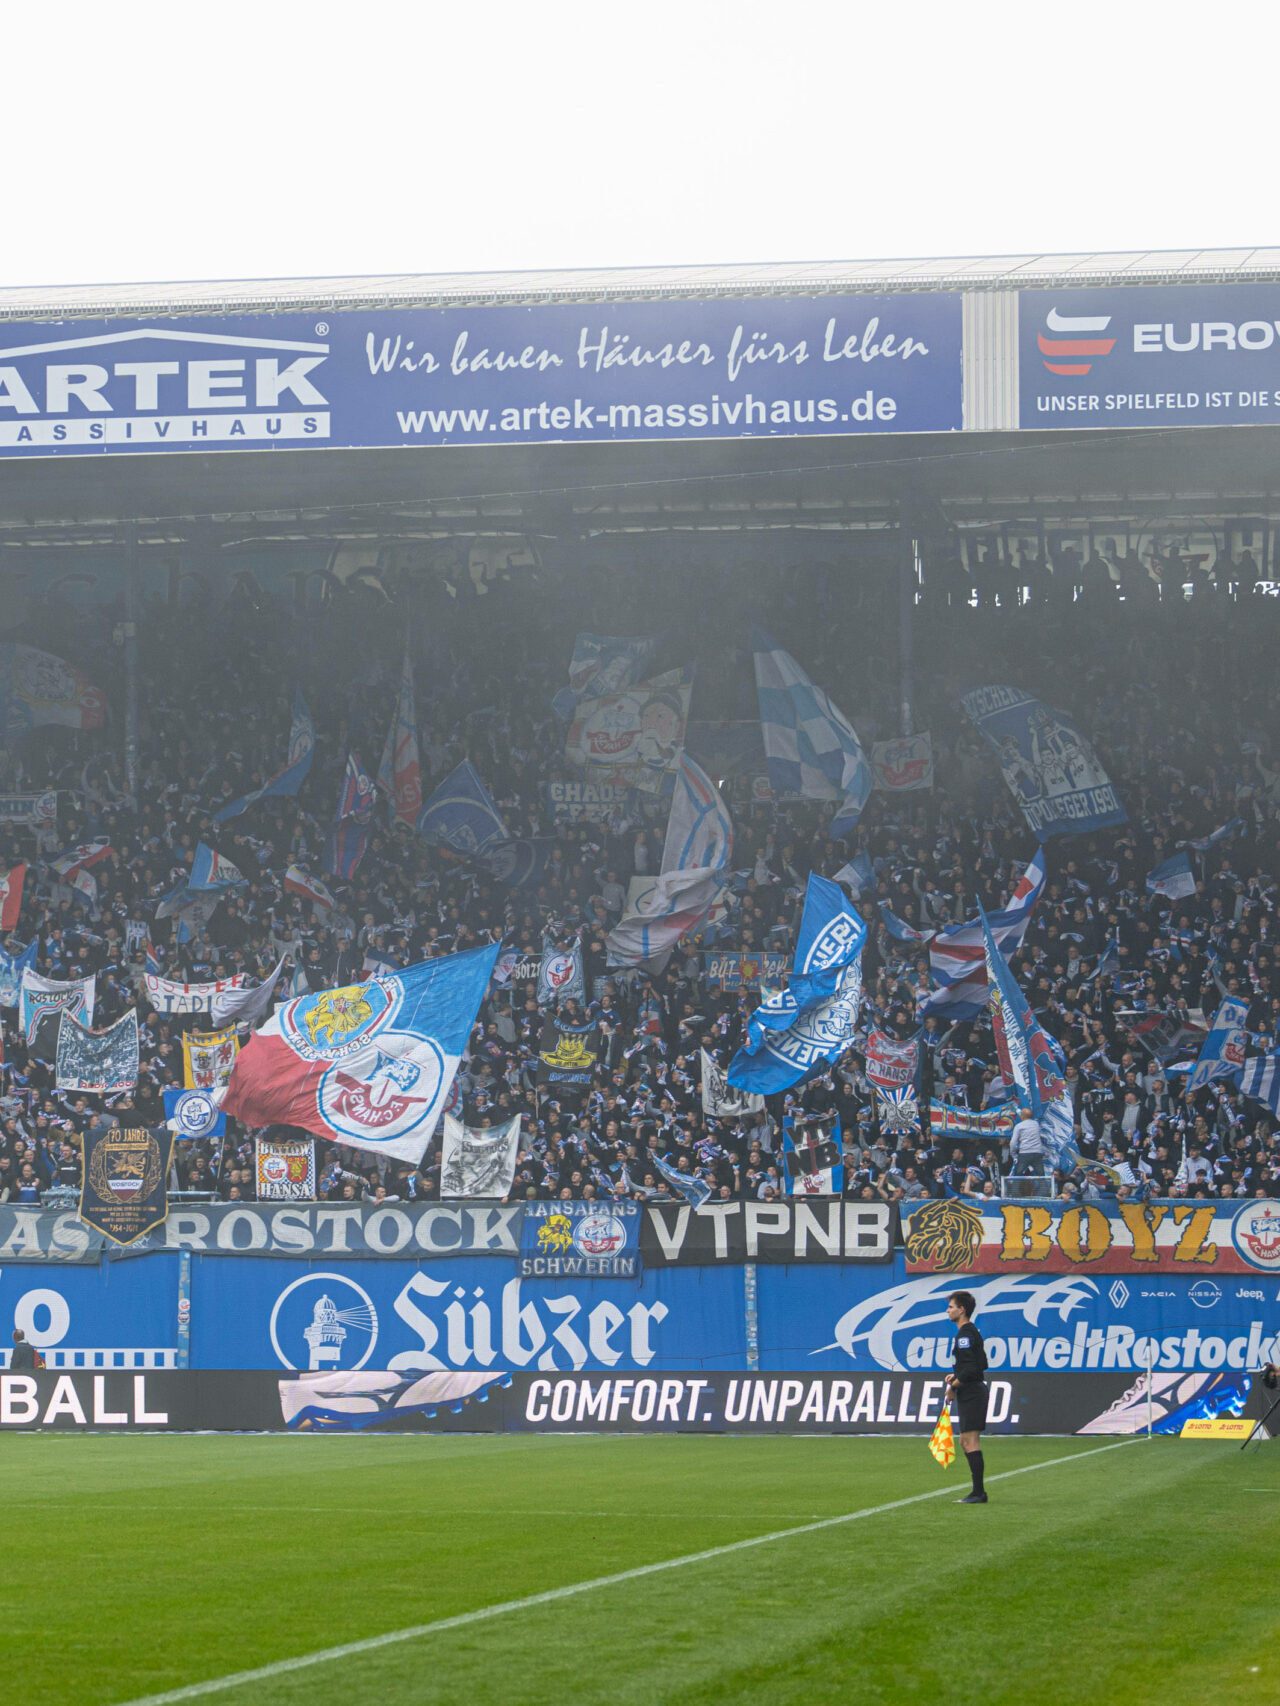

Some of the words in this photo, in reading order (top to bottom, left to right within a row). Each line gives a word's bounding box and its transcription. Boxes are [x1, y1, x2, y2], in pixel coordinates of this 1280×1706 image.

[365, 332, 441, 375] Wir
[450, 330, 565, 375] bauen
[577, 326, 715, 373] Häuser
[727, 324, 810, 382] fürs
[822, 316, 930, 363] Leben
[1133, 321, 1280, 352] EURO
[396, 390, 898, 434] www.artek-massivhaus.de
[1037, 395, 1100, 412] UNSER
[1104, 392, 1200, 411] SPIELFELD
[1205, 391, 1233, 408] IST
[1238, 390, 1269, 407] DIE
[111, 1130, 122, 1142] 70
[123, 1129, 146, 1142] JAHRE
[260, 1182, 311, 1198] HANSA
[165, 1206, 520, 1256] ROSTOCK
[646, 1203, 894, 1261] VTPNB
[998, 1202, 1220, 1265] BOYZ
[521, 1256, 636, 1276] SCHWERIN
[1235, 1288, 1264, 1301] Jeep
[386, 1270, 670, 1371] Lübzer
[907, 1321, 1274, 1369] auoweltRostock
[525, 1379, 712, 1423] COMFORT.
